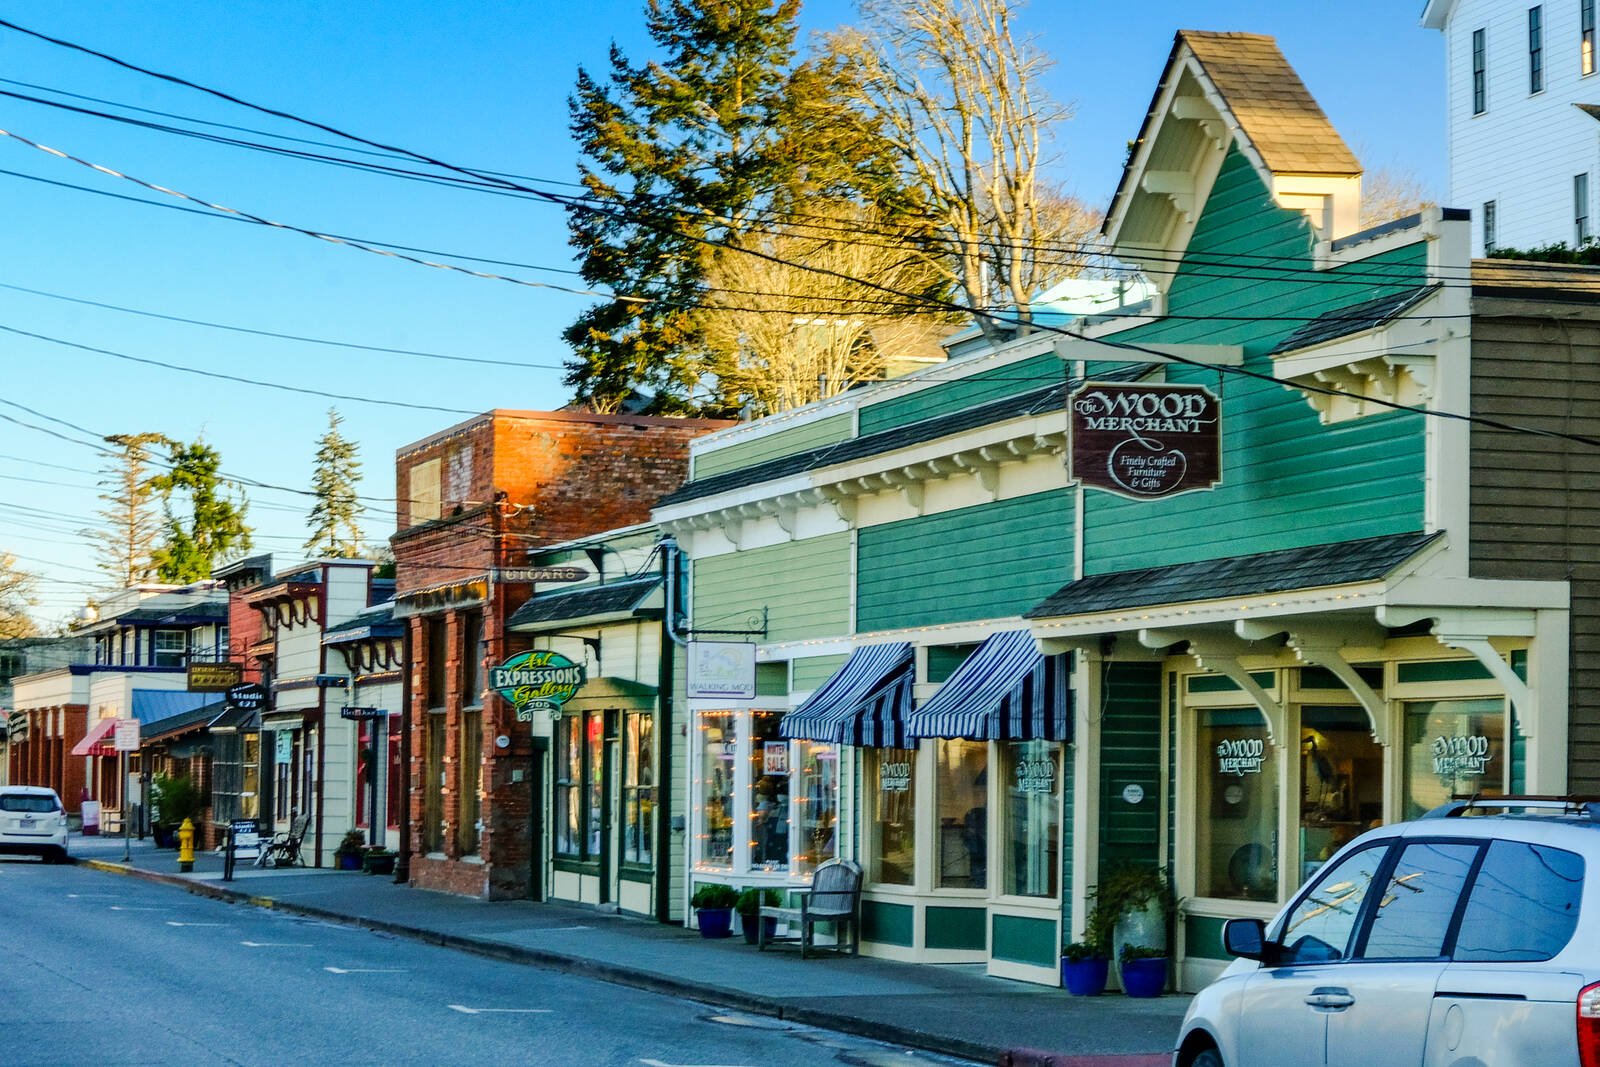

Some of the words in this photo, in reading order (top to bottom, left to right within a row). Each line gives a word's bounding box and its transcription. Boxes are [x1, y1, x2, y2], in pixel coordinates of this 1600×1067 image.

[1074, 399, 1104, 415] The
[1085, 391, 1207, 418] WOOD
[1084, 416, 1217, 433] MERCHANT
[1120, 456, 1146, 467] Finely
[1147, 456, 1177, 467] Crafted
[1127, 467, 1167, 477] Furniture
[1131, 478, 1139, 487] &
[1140, 477, 1161, 489] Gifts
[512, 653, 554, 671] Art
[495, 666, 582, 688] EXPRESSIONS
[513, 682, 575, 708] Gallery
[1221, 739, 1264, 757] WOOD
[767, 757, 786, 772] SALE
